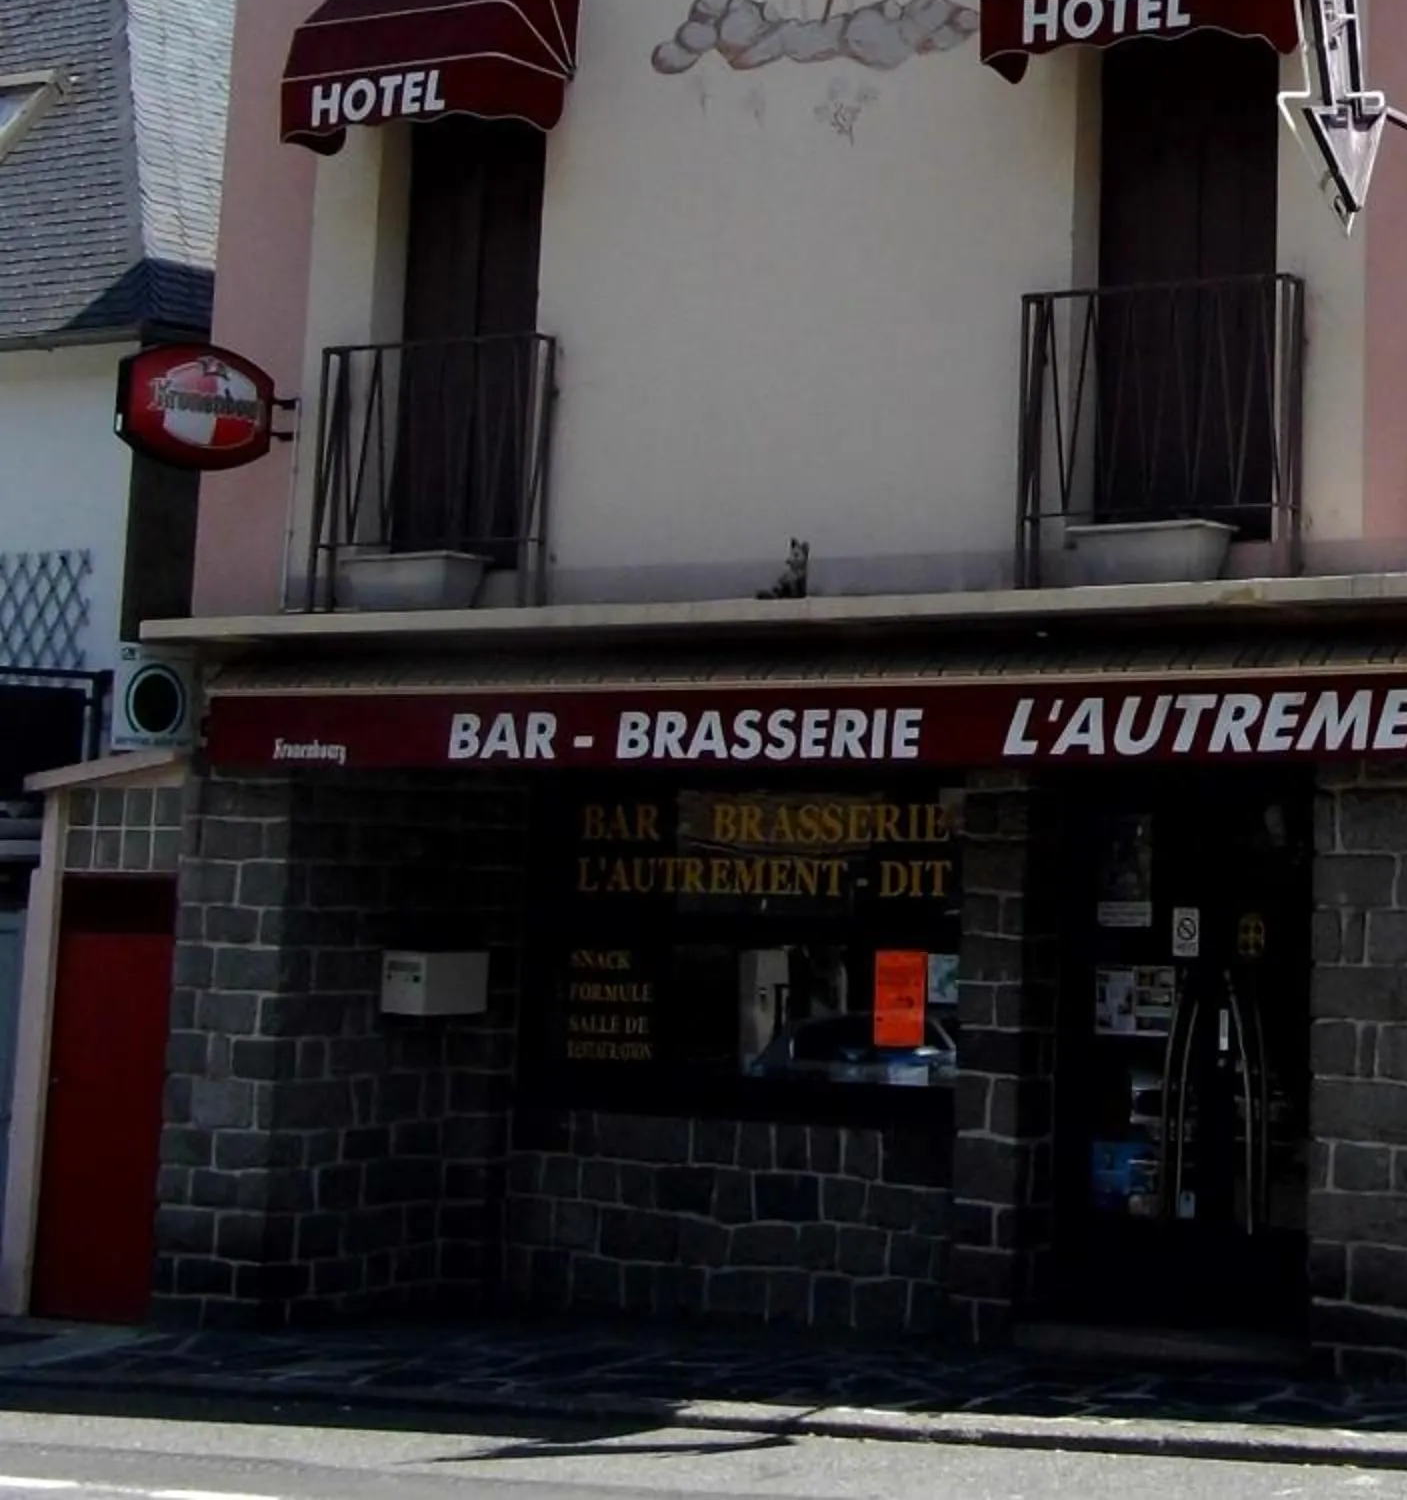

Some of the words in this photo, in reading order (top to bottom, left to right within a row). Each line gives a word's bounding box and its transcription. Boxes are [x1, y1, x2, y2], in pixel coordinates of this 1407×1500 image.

[311, 69, 445, 128] HOTEL
[447, 712, 557, 760] BAR
[615, 708, 924, 759] BRASSERIE
[582, 802, 661, 842] BAR
[713, 802, 951, 843] BRASSERIE
[577, 856, 849, 898] L'AUTREMENT
[880, 860, 953, 899] DIT
[625, 1015, 650, 1035] DE
